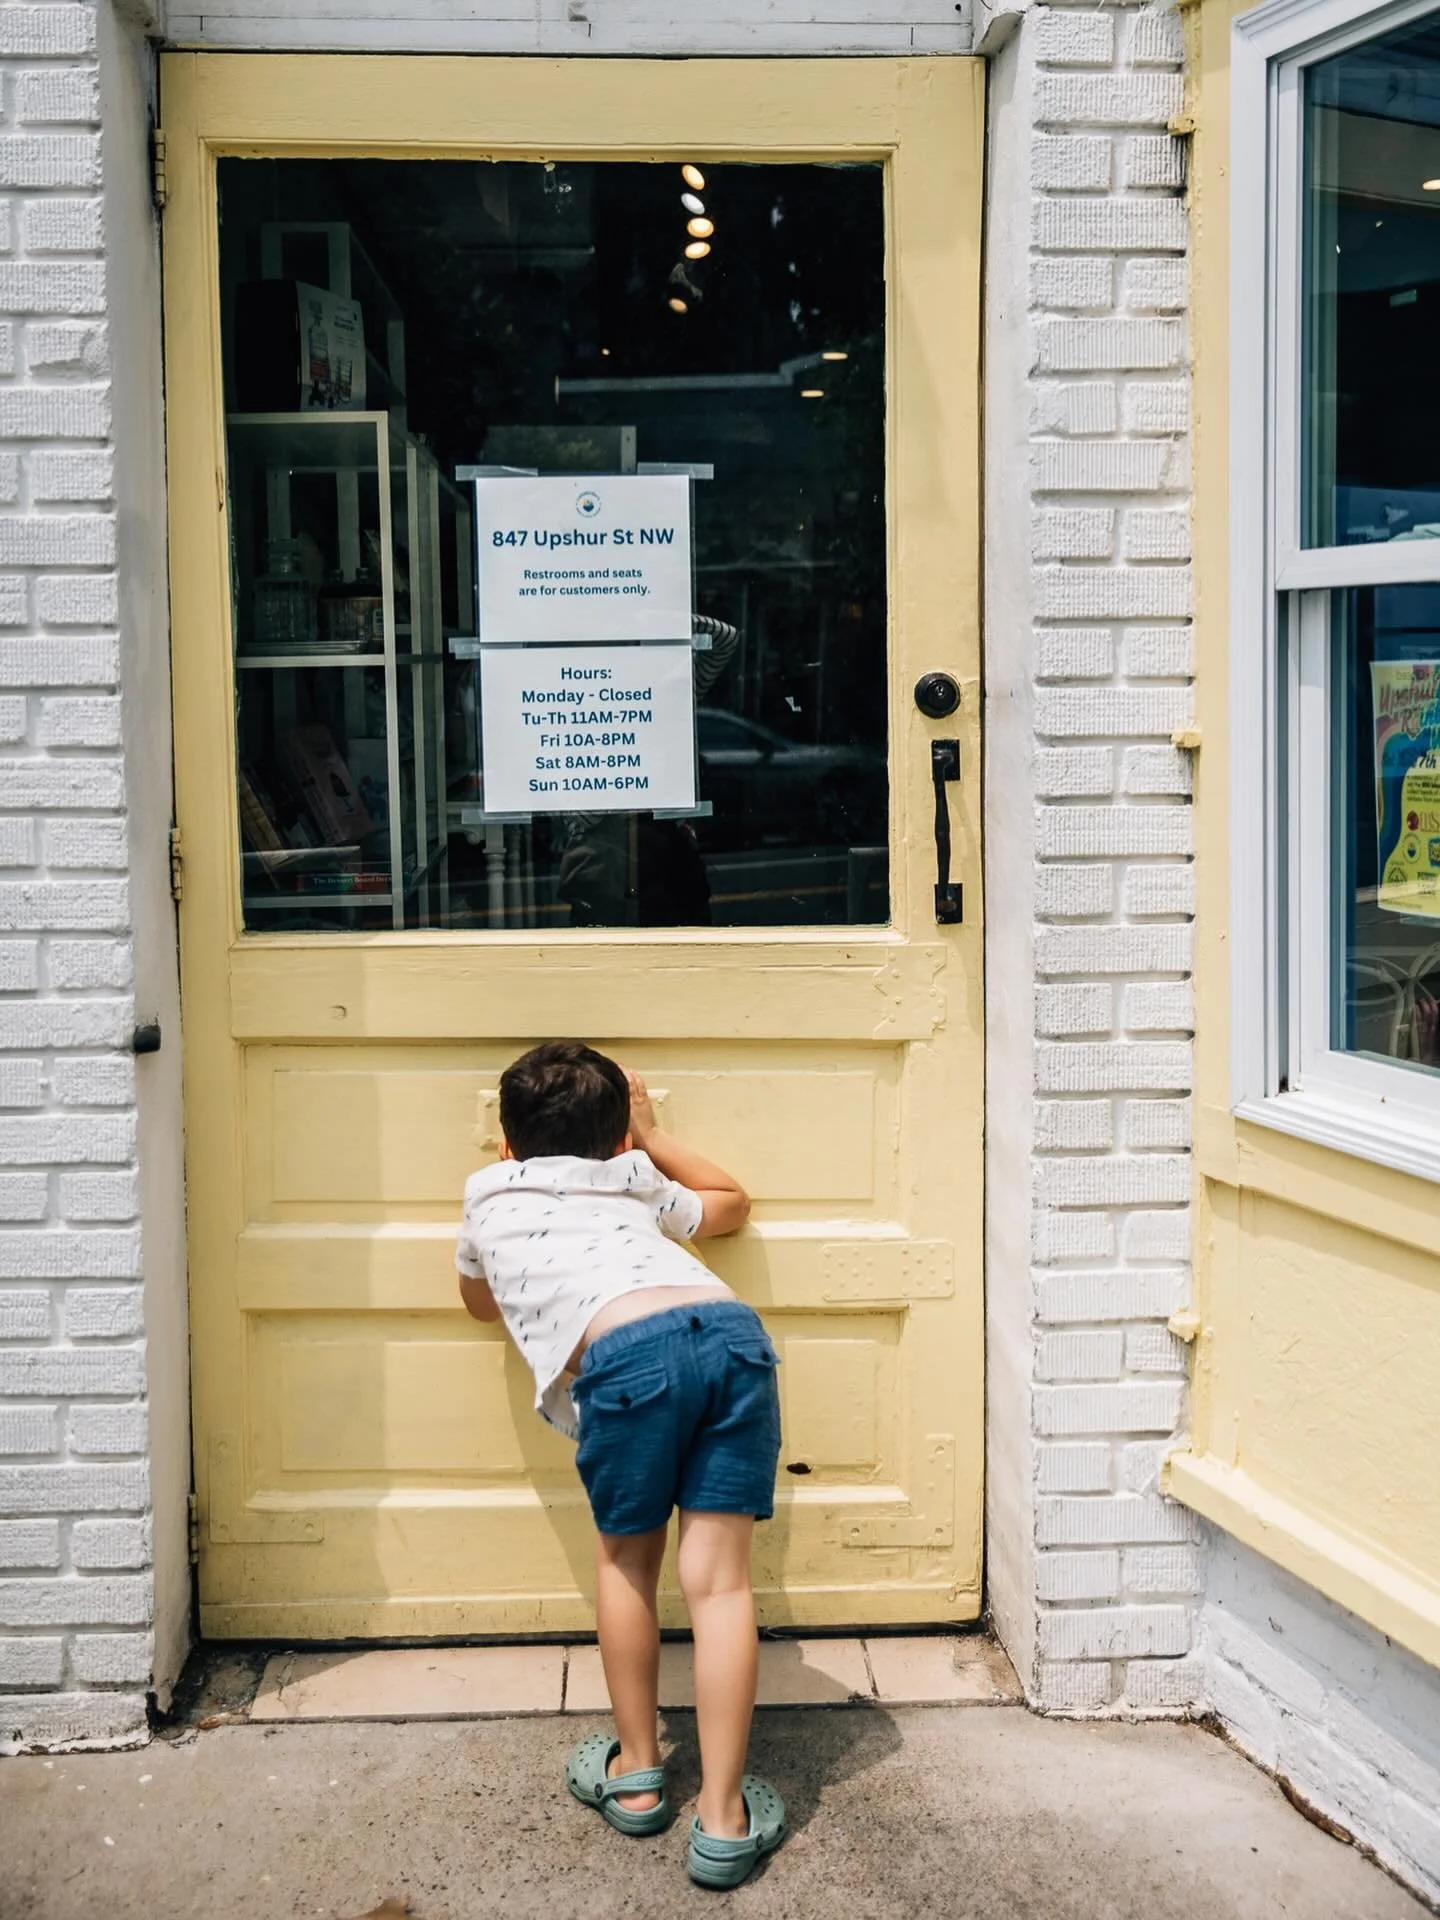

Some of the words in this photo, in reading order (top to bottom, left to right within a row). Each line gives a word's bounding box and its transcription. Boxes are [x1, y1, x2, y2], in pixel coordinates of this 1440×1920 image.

[493, 530, 528, 547] 847
[534, 529, 607, 551] Upshur
[613, 529, 634, 546] St
[640, 528, 675, 545] NW
[524, 569, 586, 580] Restrooms
[588, 568, 610, 579] and
[612, 568, 643, 578] seats
[518, 588, 538, 596] are
[540, 585, 557, 596] for
[560, 586, 620, 596] customers
[623, 584, 651, 597] only.
[561, 667, 612, 681] Hours:
[522, 689, 584, 706] Monday
[599, 688, 652, 702] Closed
[522, 711, 567, 726] Tu-Th
[571, 710, 653, 725] 11AM-7PM
[540, 733, 560, 748] Fri
[564, 732, 636, 747] 10A-8PM
[535, 756, 561, 770] Sat
[565, 755, 641, 769] 8AM-8PM
[529, 779, 559, 792] Sun
[562, 777, 649, 791] 10AM-6PM
